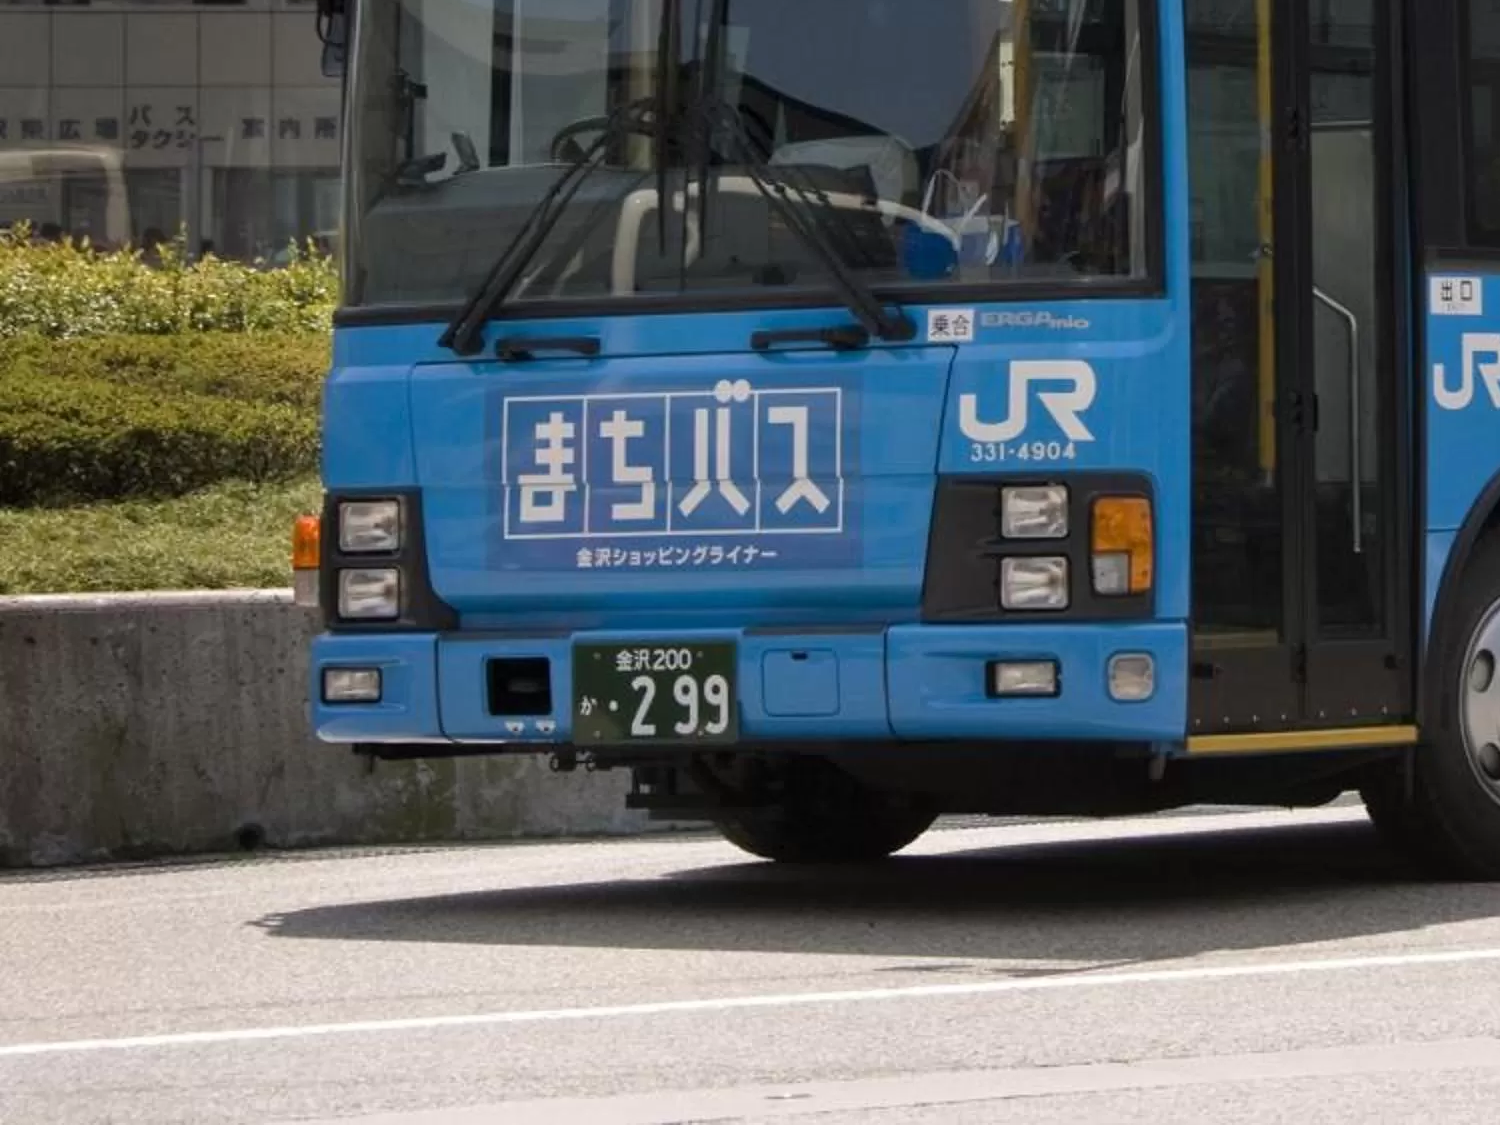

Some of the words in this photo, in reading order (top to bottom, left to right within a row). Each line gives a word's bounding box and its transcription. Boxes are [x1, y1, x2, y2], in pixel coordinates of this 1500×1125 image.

[131, 128, 225, 150] タクシー
[931, 315, 970, 336] 乗合
[959, 360, 1096, 442] JR
[517, 378, 831, 522] まちバス
[576, 546, 777, 568] 金沢ショッピングライナー
